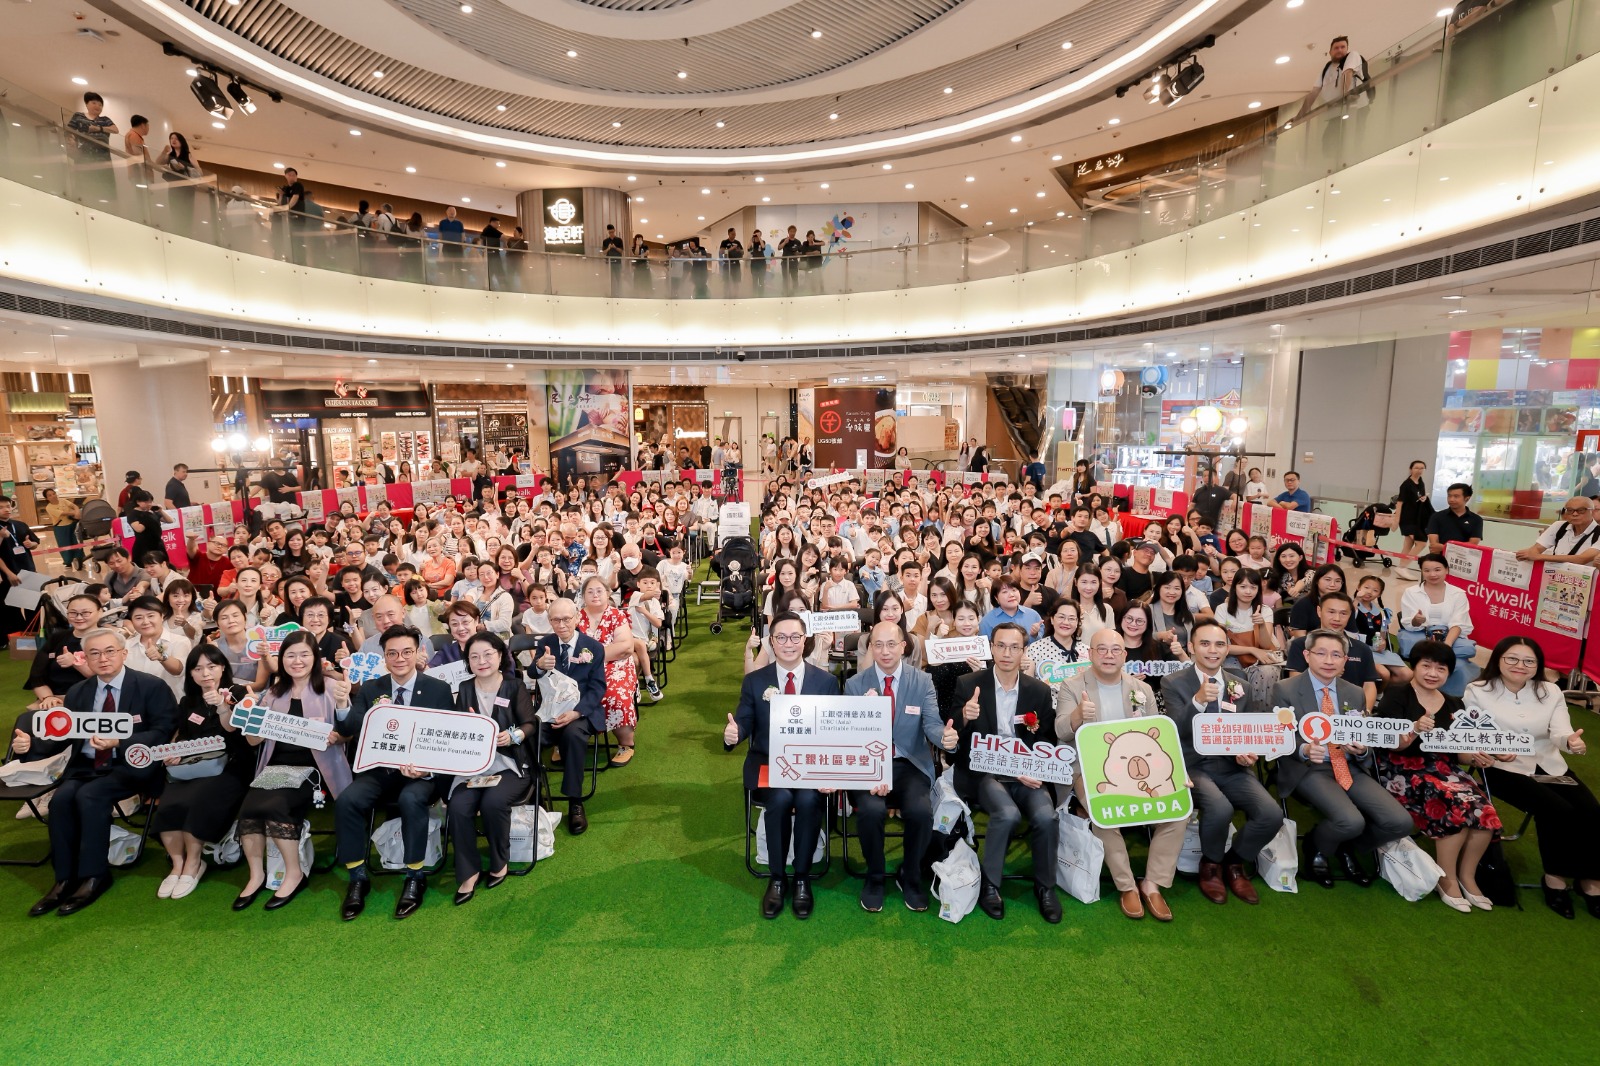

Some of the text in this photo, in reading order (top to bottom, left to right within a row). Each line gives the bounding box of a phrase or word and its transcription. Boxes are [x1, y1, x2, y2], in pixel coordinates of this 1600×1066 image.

[1467, 582, 1534, 611] citywalk
[1488, 604, 1531, 626] 荃新天地
[352, 654, 380, 671] 樂學
[36, 716, 129, 733] I ICBC
[267, 713, 309, 727] 香港教育大學
[1333, 718, 1410, 731] SINO GROUP
[267, 730, 282, 739] Hong
[283, 734, 296, 742] Kong
[275, 725, 300, 736] Education
[300, 730, 326, 742] University
[420, 727, 484, 742] 工銀亞洲慈善基金
[1201, 724, 1284, 734] 全港幼兒和小學生
[1202, 735, 1284, 745] 普通話評測挑戰賽
[1334, 730, 1395, 744] 信和集團
[1424, 731, 1530, 745] 中華文化教育中心
[415, 744, 481, 756] Charitable Foundation
[792, 754, 870, 766] 工銀社區學堂
[972, 750, 1072, 776] 香港語言研究中心
[1029, 772, 1050, 780] STUDIES
[1102, 800, 1182, 819] HKPPDA
